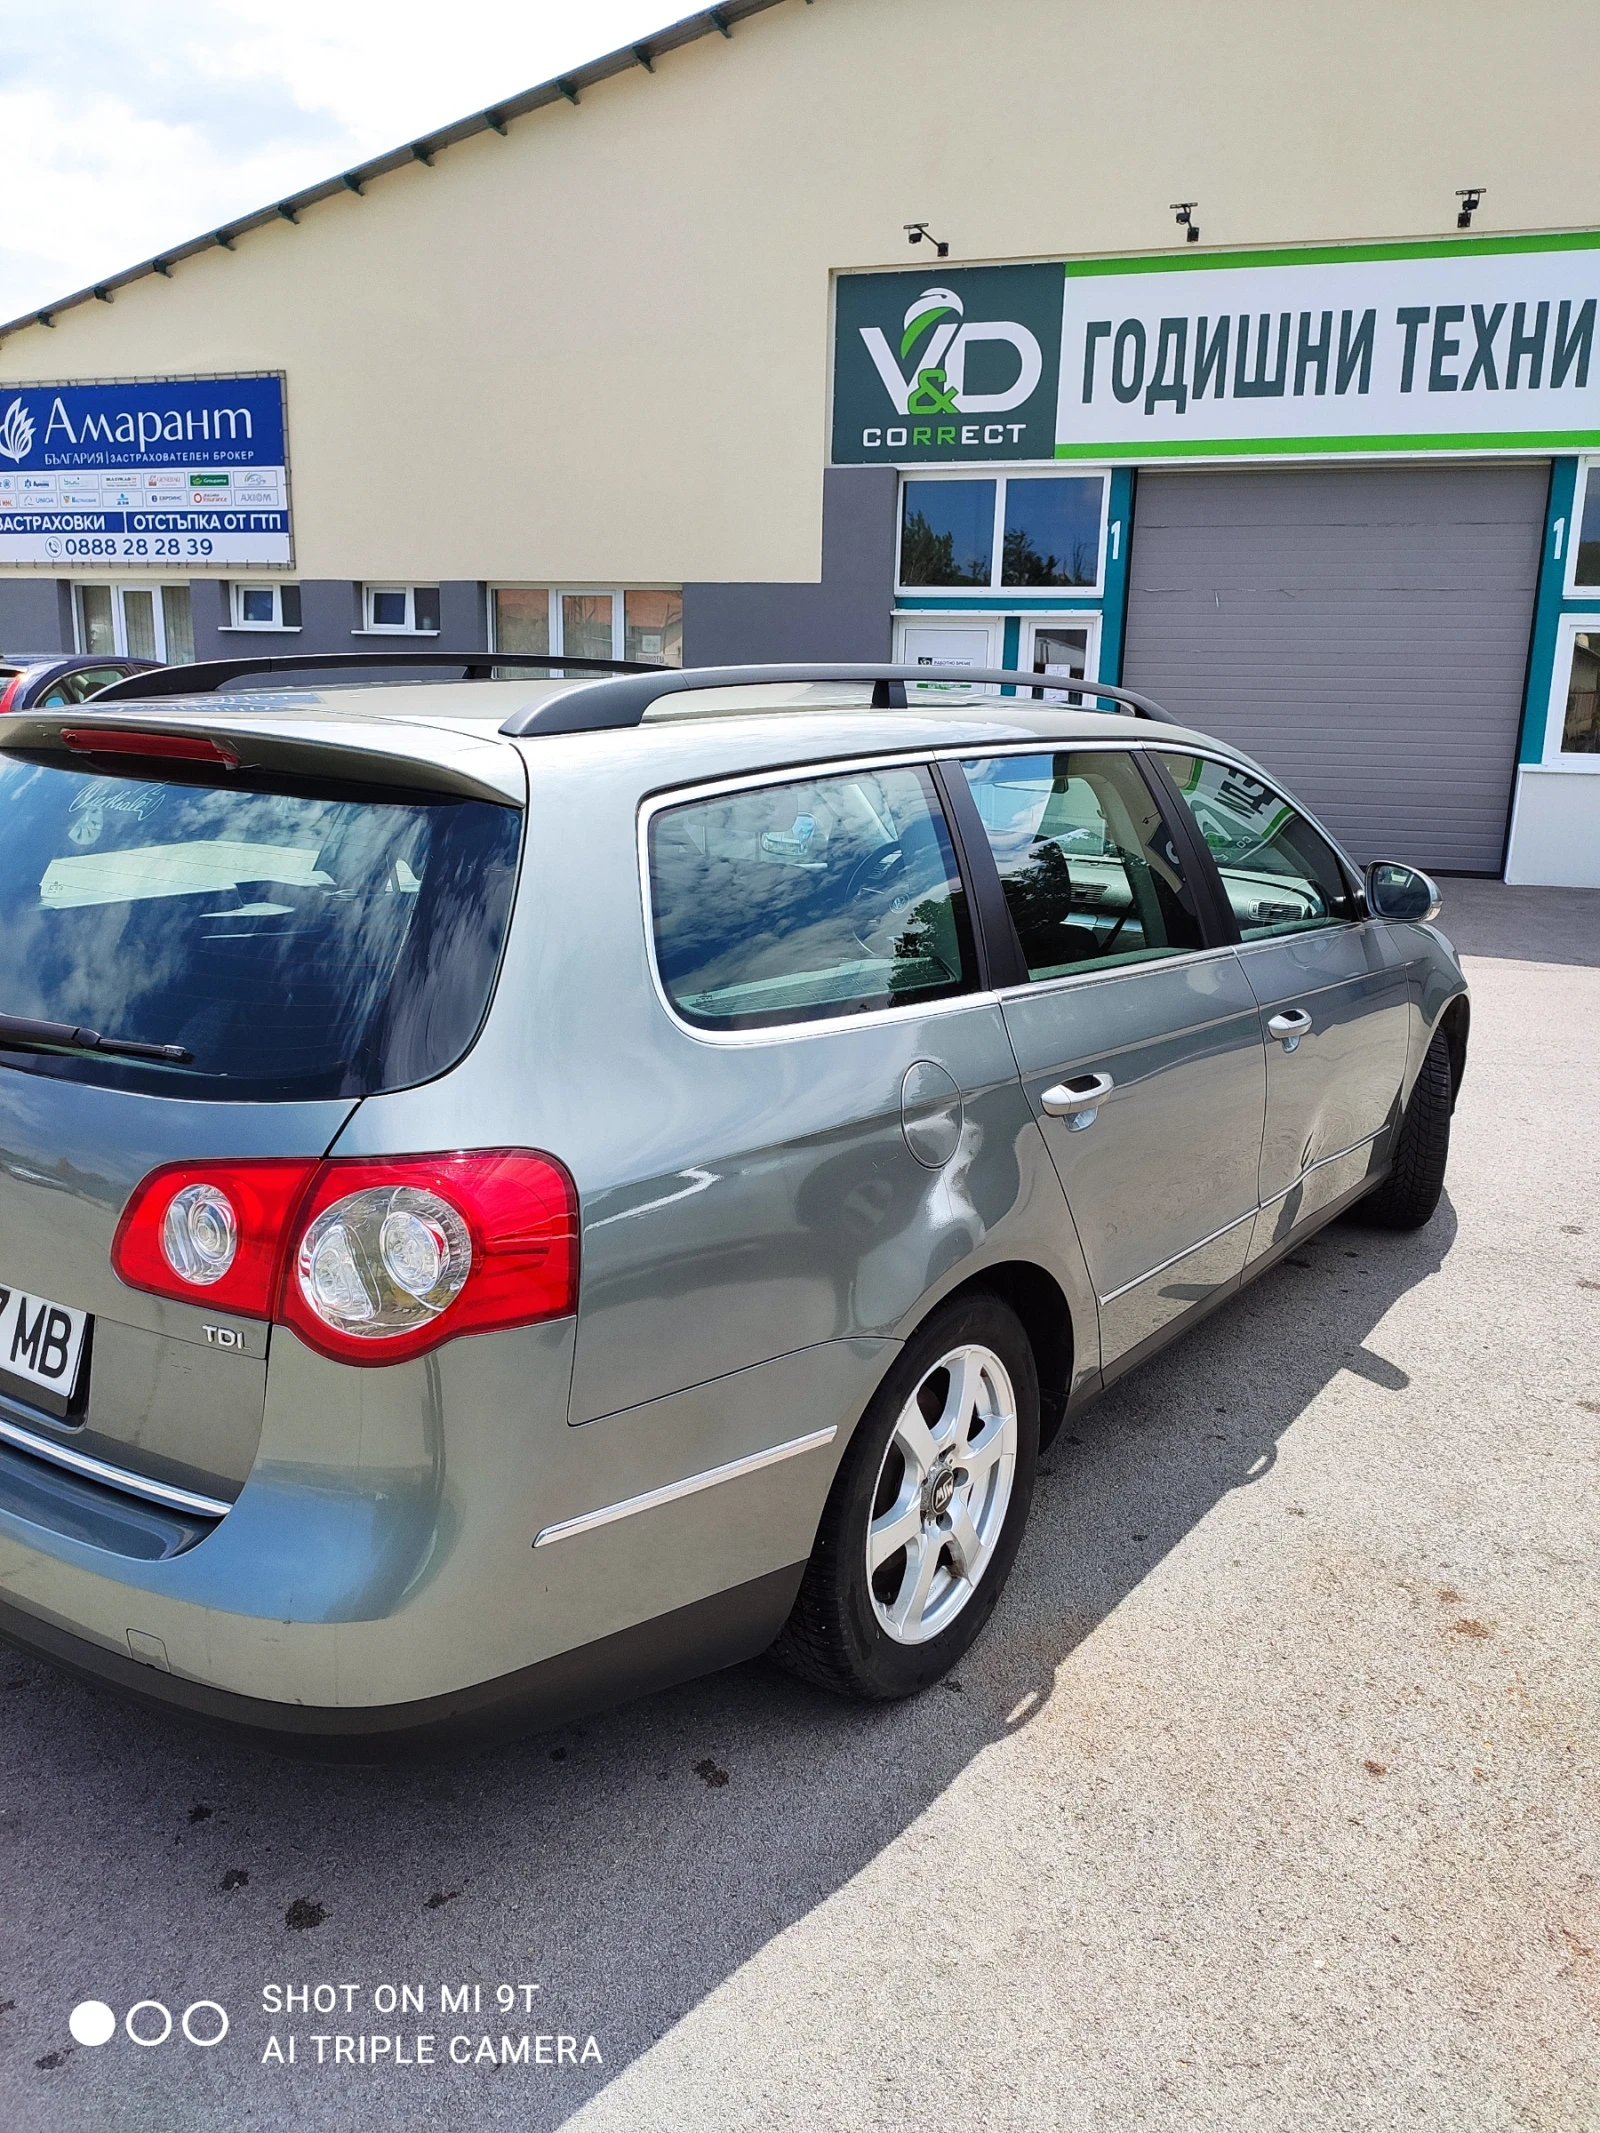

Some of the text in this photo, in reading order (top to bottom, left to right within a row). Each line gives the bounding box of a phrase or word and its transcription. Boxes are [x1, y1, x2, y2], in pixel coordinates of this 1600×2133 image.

[858, 320, 1043, 415] V&D
[1081, 298, 1598, 415] ГОДИШНИ ТЕХНИ
[44, 397, 253, 453] Амарант
[862, 423, 1027, 447] CORRECT
[44, 450, 255, 465] БЪЛГАРИЯ ЗАСТРАХОВАТЕЛЕН БРОКЕР
[133, 513, 281, 530] ОТСТЪПКА ОТ ГТП
[1111, 520, 1121, 560] 1
[1553, 517, 1565, 560] 1
[65, 538, 213, 556] 0888 28 28 39
[9, 1296, 72, 1379] MB
[202, 1323, 245, 1350] TDI
